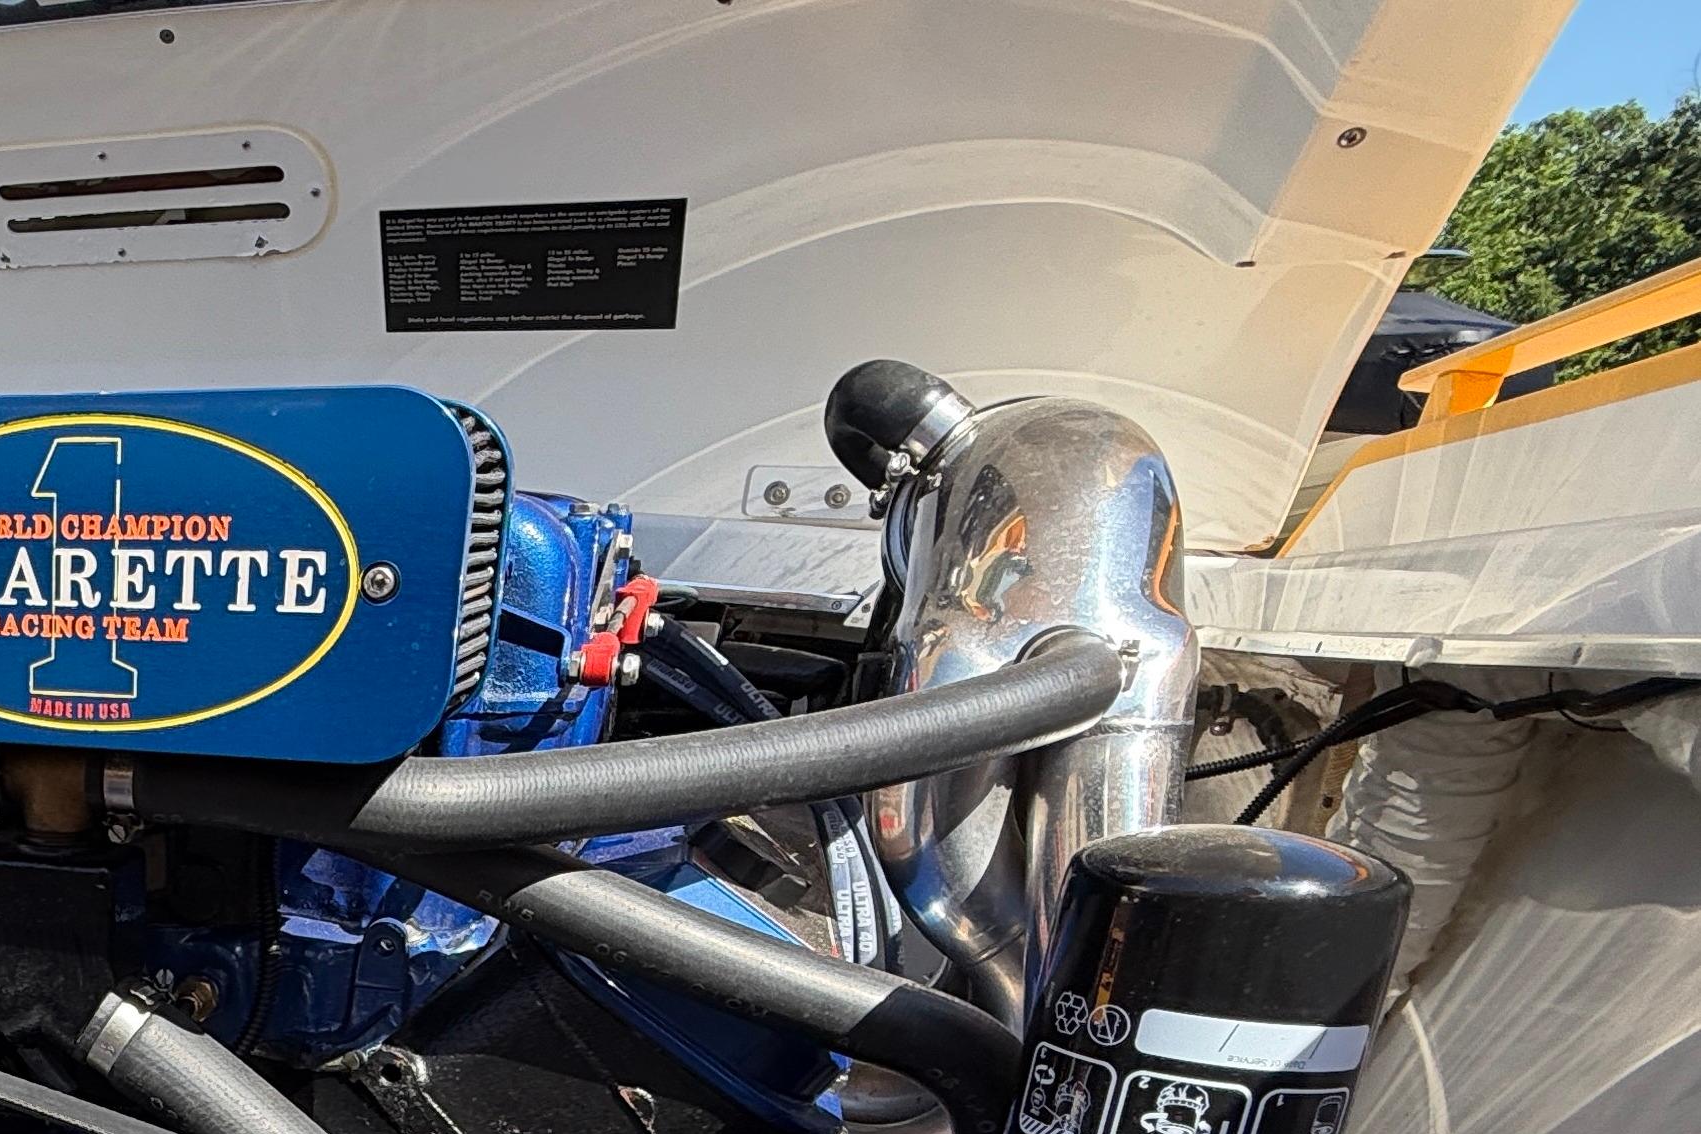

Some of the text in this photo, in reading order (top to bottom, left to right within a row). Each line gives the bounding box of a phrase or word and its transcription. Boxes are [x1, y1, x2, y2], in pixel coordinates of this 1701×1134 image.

[61, 511, 233, 543] CHAMPION
[102, 615, 190, 644] TEAM
[29, 696, 132, 720] MADE IN USA
[852, 880, 873, 954] ULTRA 40
